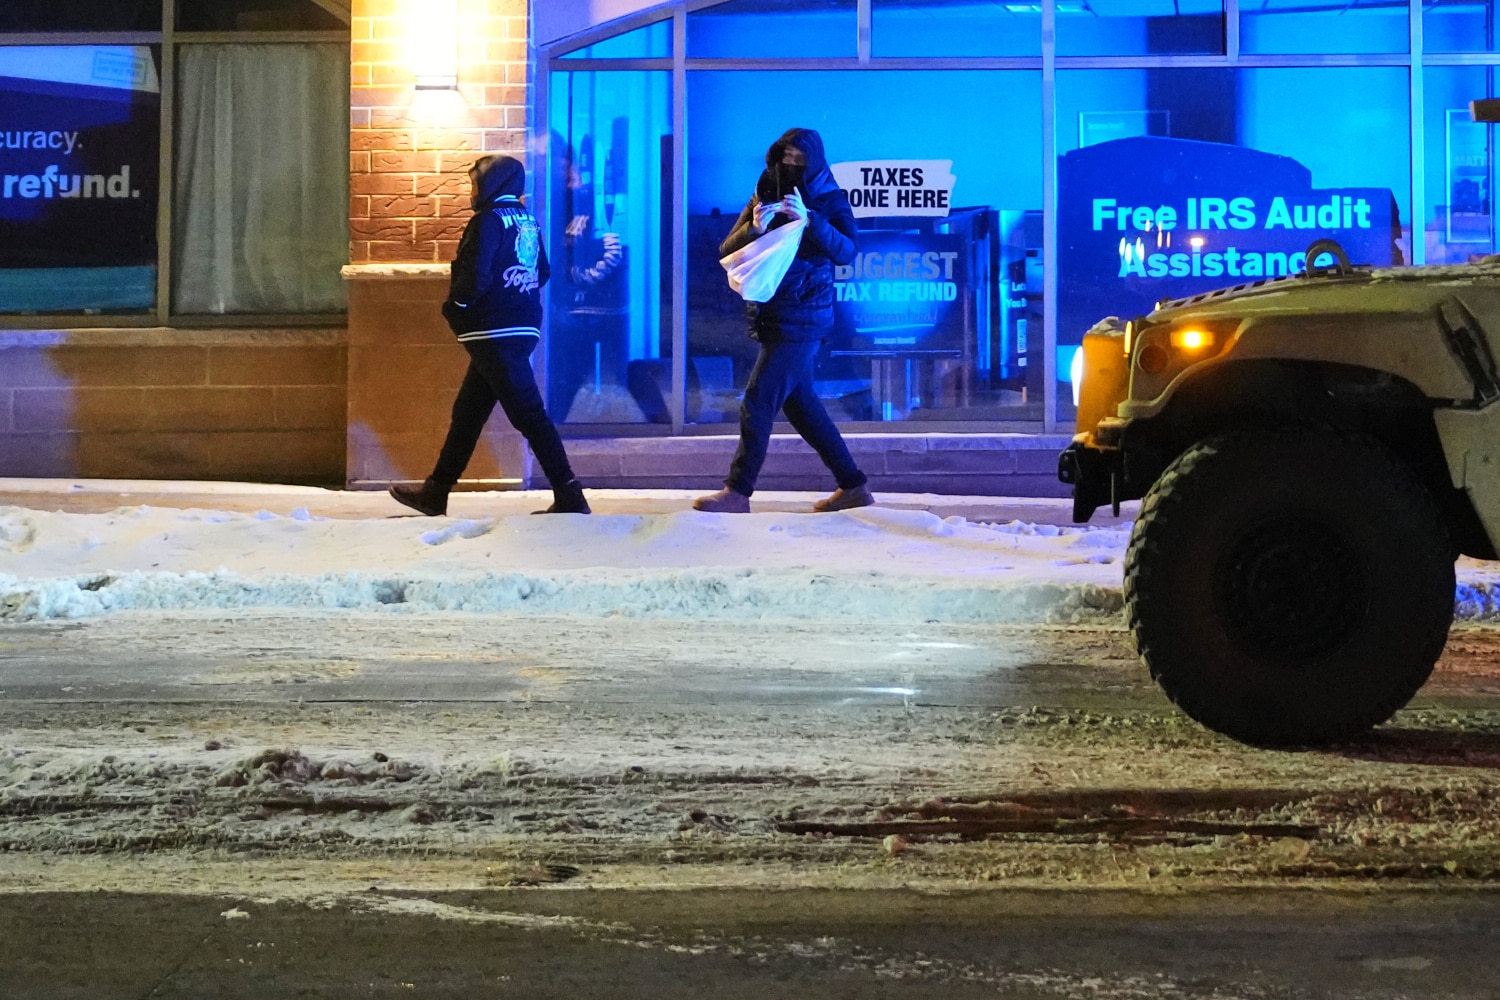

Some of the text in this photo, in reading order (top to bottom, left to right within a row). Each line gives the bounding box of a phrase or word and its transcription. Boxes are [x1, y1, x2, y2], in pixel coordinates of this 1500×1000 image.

[0, 131, 83, 154] uracy.
[3, 164, 140, 198] refund.
[860, 167, 924, 187] TAXES
[896, 189, 949, 208] HERE
[1092, 195, 1371, 231] Free IRS Audit
[834, 251, 958, 280] BIGGEST
[1117, 246, 1334, 278] Assistance
[833, 281, 958, 302] TAX REFUND
